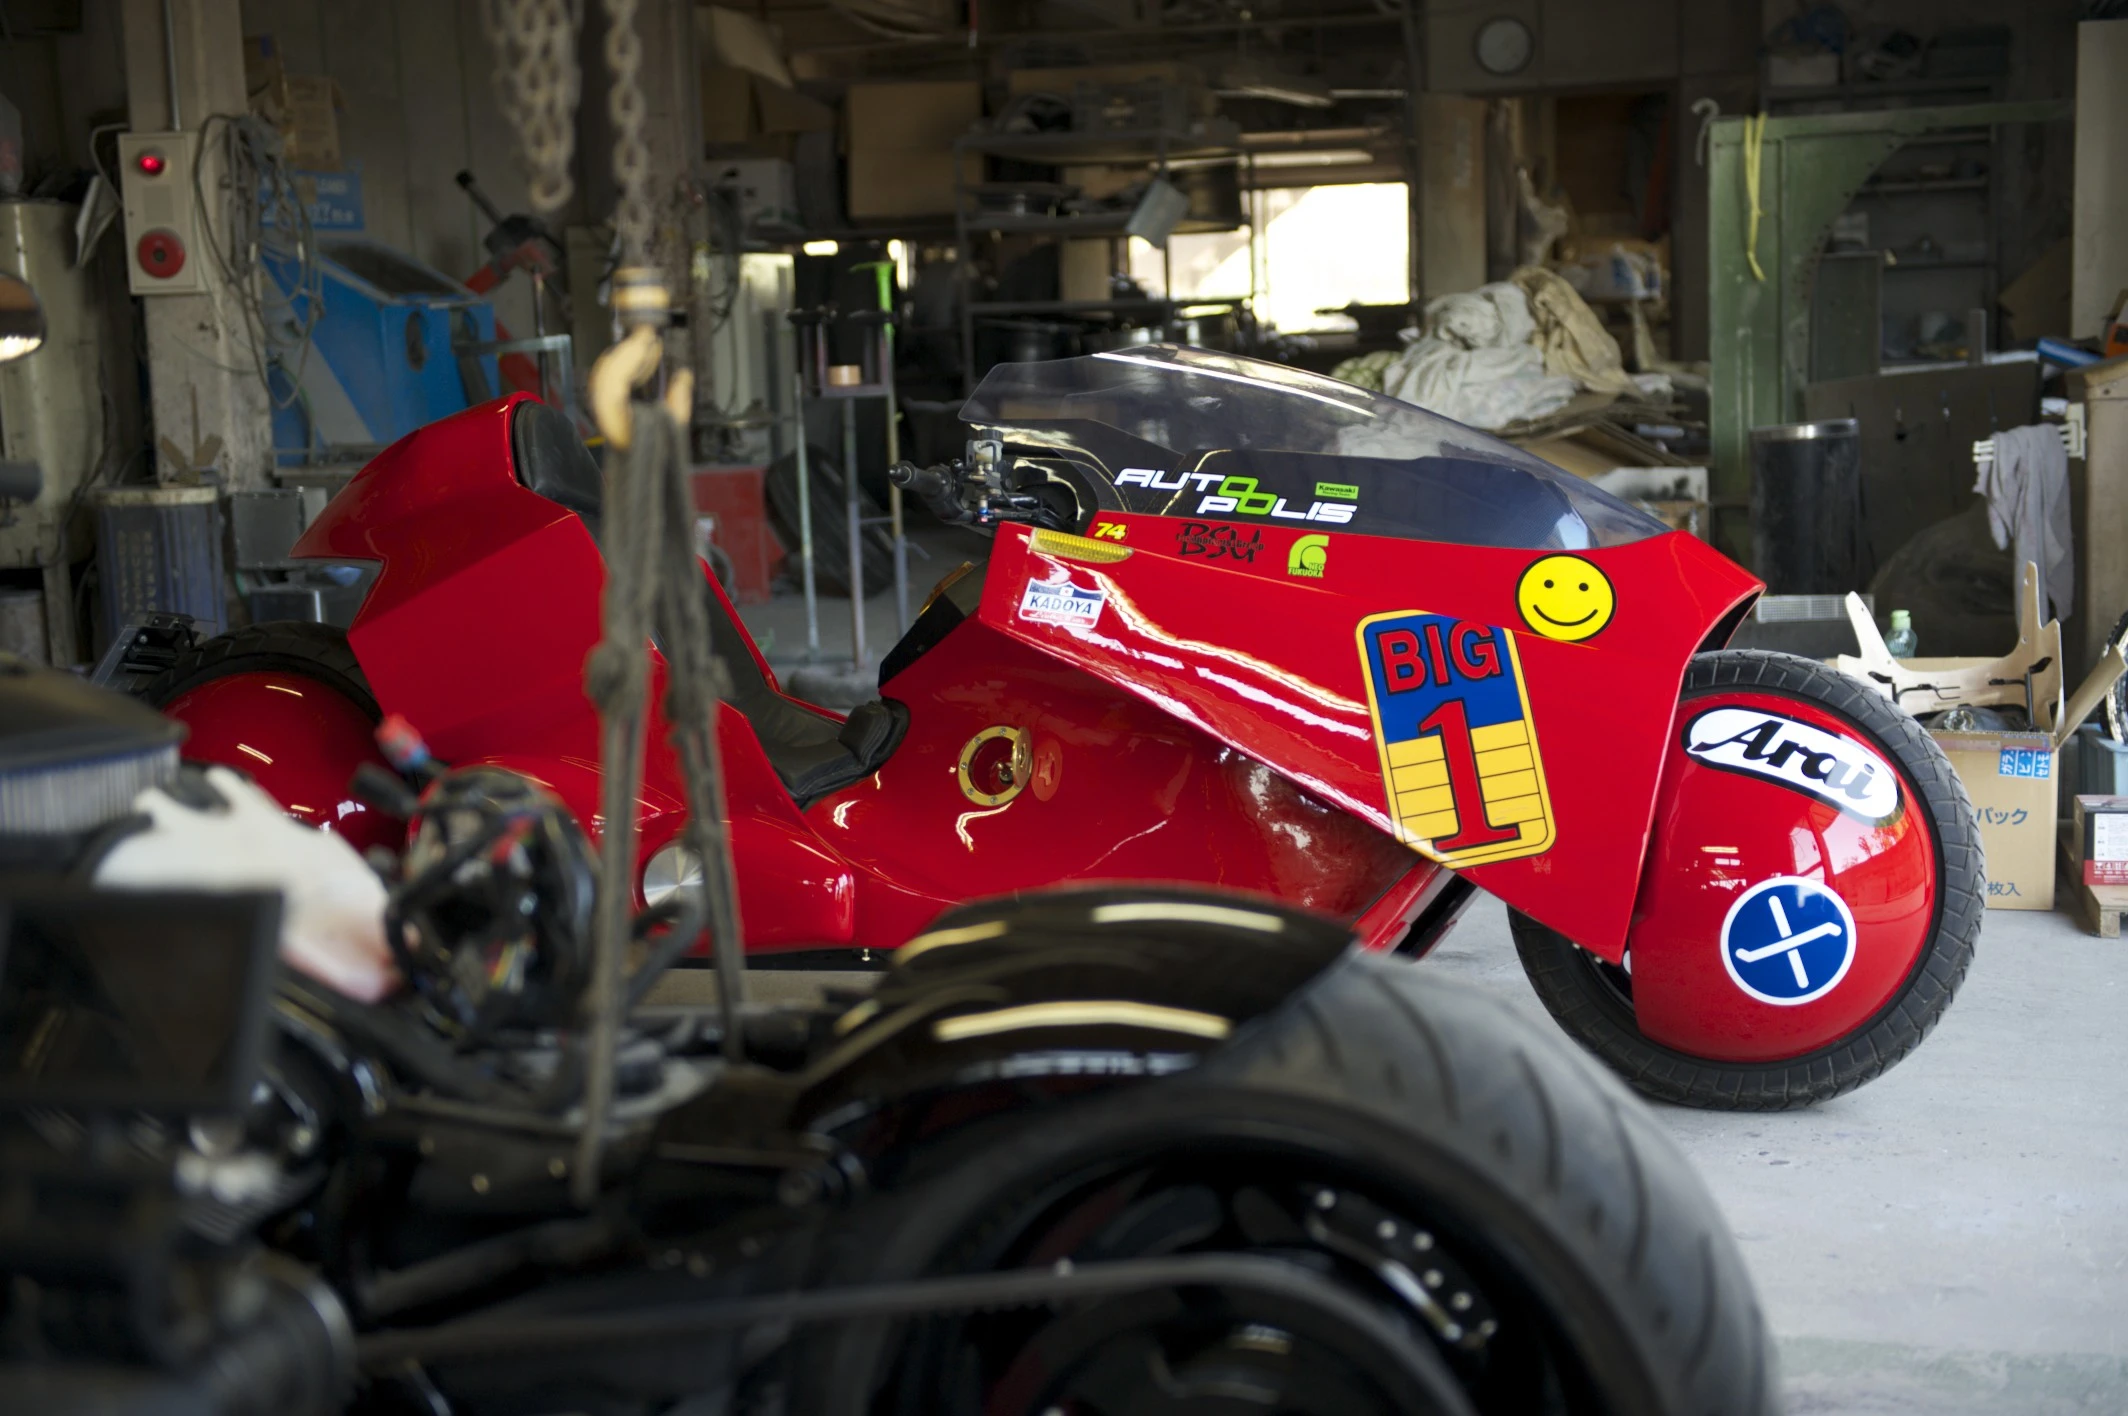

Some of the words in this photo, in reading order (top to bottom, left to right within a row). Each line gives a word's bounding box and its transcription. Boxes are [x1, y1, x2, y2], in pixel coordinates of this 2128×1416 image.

[1318, 484, 1356, 494] Kawasaki
[1196, 491, 1358, 524] POLIS
[1094, 521, 1127, 540] 74
[1288, 567, 1324, 578] FUKUOKA
[1309, 562, 1325, 571] NEO
[1029, 595, 1093, 615] KADOYA
[1376, 620, 1504, 695] BIG
[1690, 719, 1876, 800] Arai
[1418, 698, 1522, 855] 1
